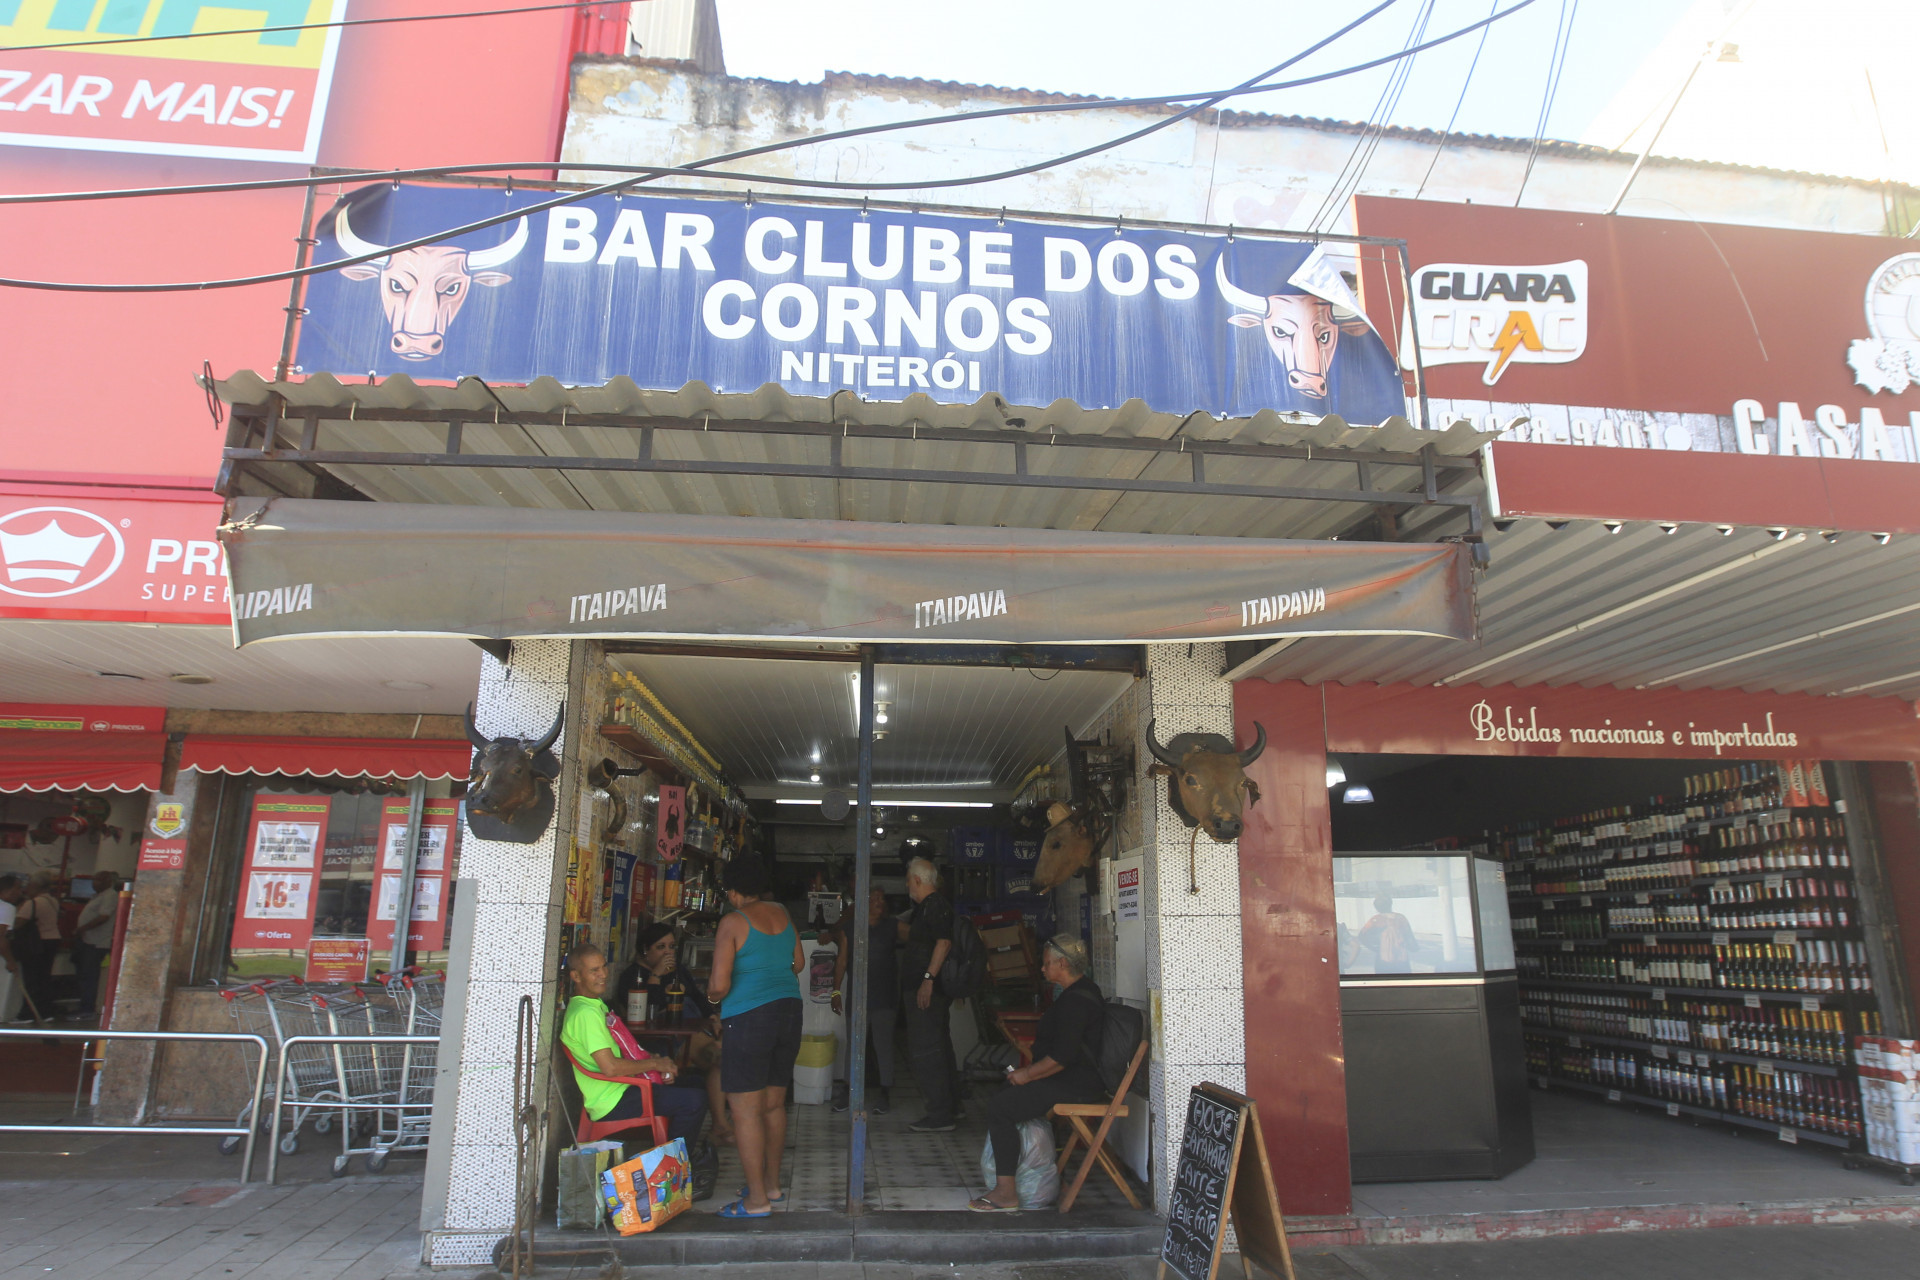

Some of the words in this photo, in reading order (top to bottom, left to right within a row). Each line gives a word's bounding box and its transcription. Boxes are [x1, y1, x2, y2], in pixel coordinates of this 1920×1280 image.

[121, 79, 295, 129] MAIS!
[544, 205, 716, 272] BAR
[744, 216, 1014, 289] CLUBE
[1043, 236, 1200, 300] DOS
[1420, 271, 1576, 303] GUARA
[702, 279, 1053, 356] CORNOS
[1418, 310, 1577, 370] CRAC
[780, 350, 981, 391] NITERÓI
[1733, 399, 1896, 460] CASA
[569, 583, 668, 624] ITAIPAVA
[914, 588, 1008, 629] ITAIPAVA
[1241, 587, 1327, 627] ITAIPAVA
[1470, 699, 1562, 744] Bebidas
[1569, 718, 1665, 745] nacionais
[1672, 731, 1684, 745] e
[1689, 711, 1798, 755] importadas
[263, 881, 288, 908] 16
[1118, 870, 1138, 886] VENDE-SE
[266, 931, 292, 939] Oferta
[1193, 1099, 1234, 1142] HOJE
